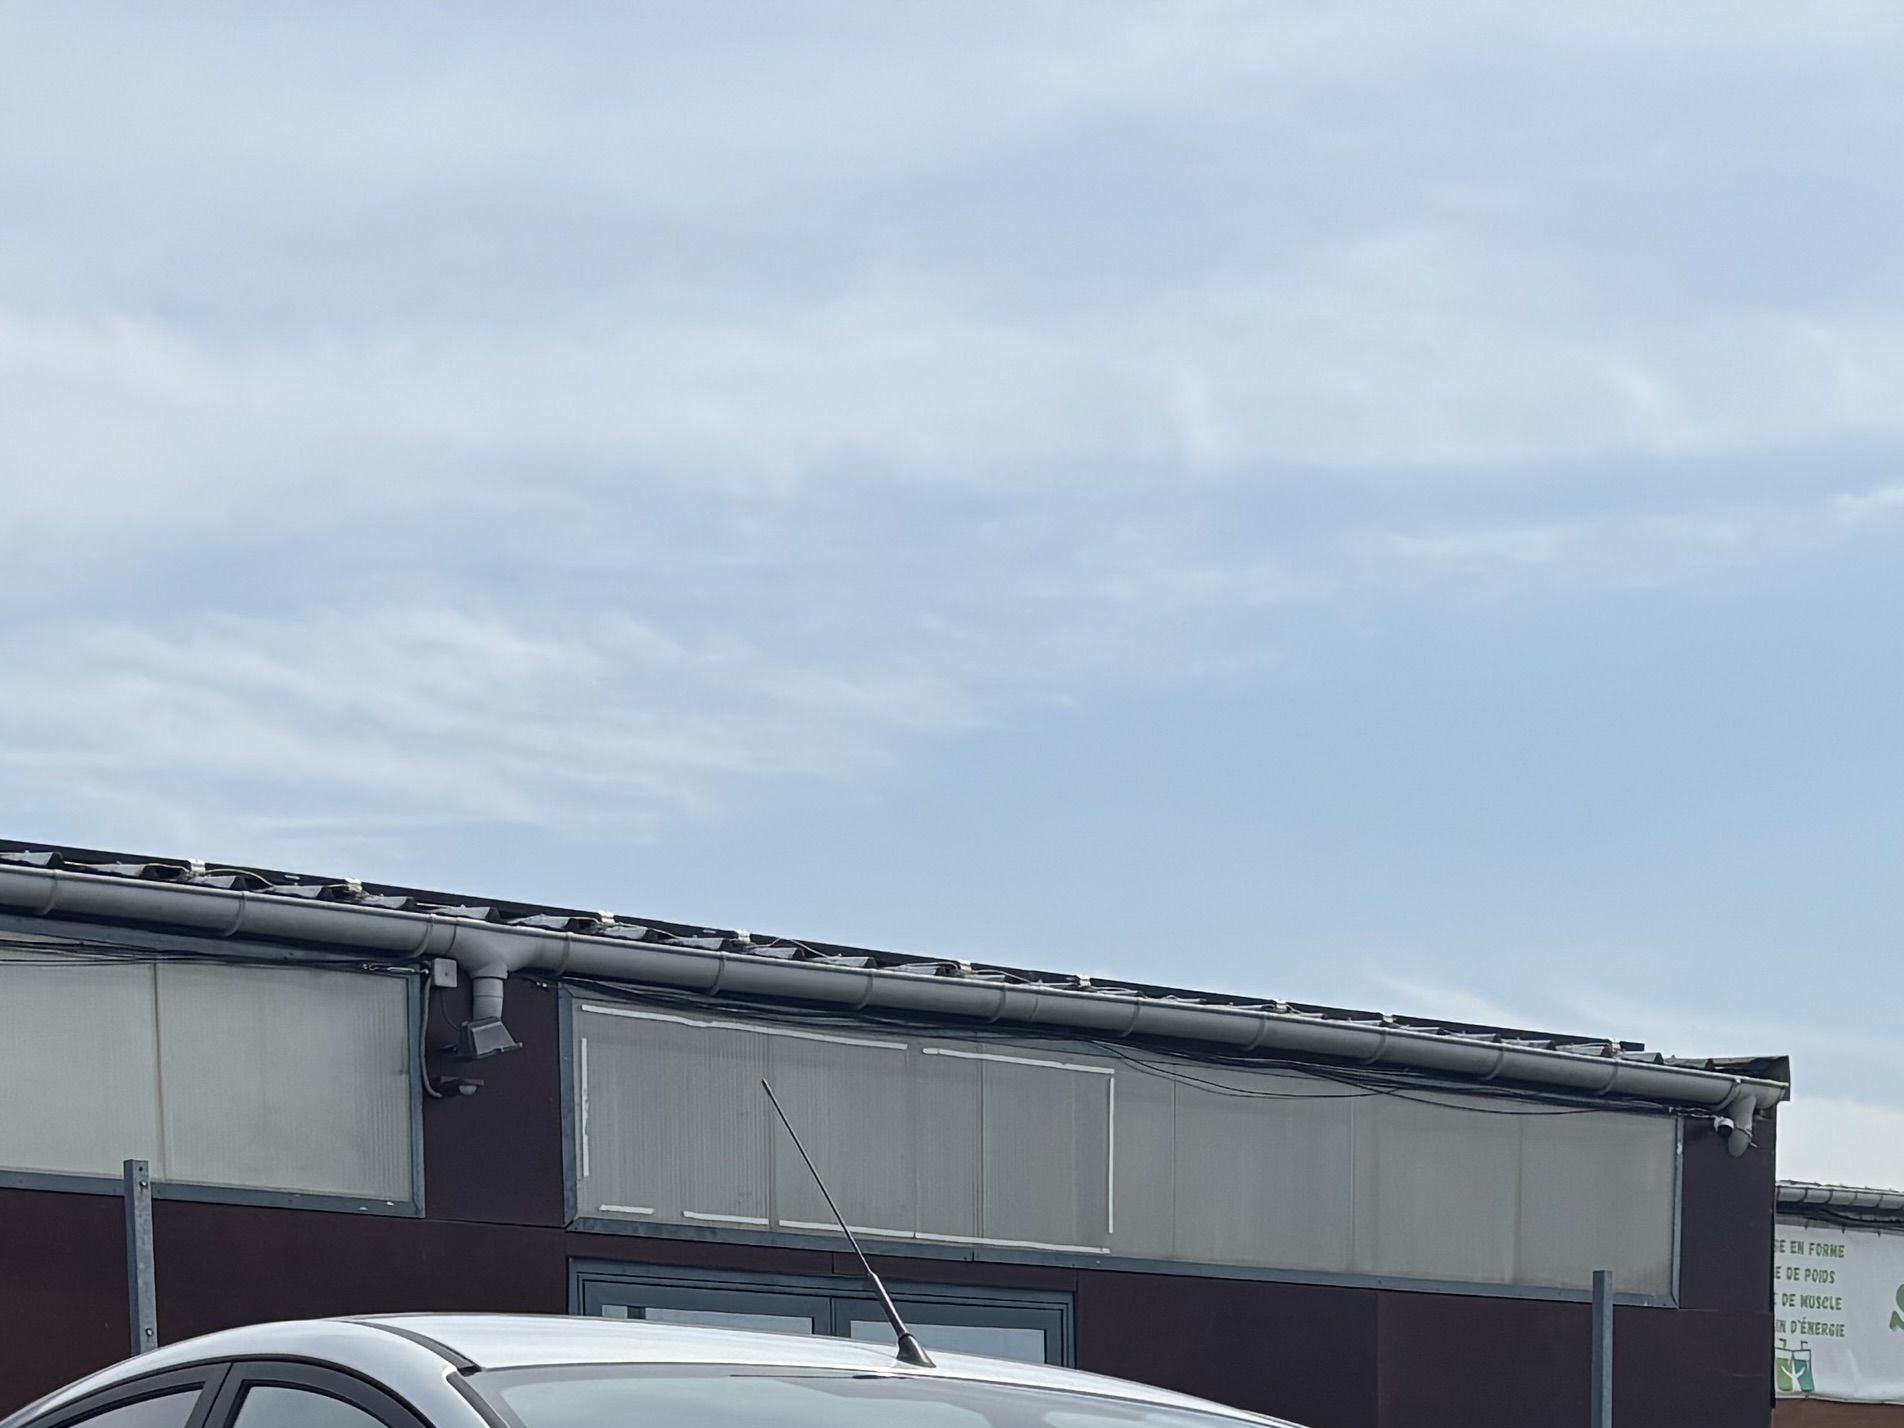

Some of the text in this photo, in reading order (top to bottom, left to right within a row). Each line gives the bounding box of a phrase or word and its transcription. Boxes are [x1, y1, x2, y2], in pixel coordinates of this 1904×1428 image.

[1809, 1242, 1845, 1259] FORME
[1786, 1267, 1800, 1281] DE
[1804, 1268, 1836, 1284] POIDS
[1782, 1293, 1842, 1311] DE MUSCLE
[1790, 1316, 1845, 1337] D'ÉNERGIE
